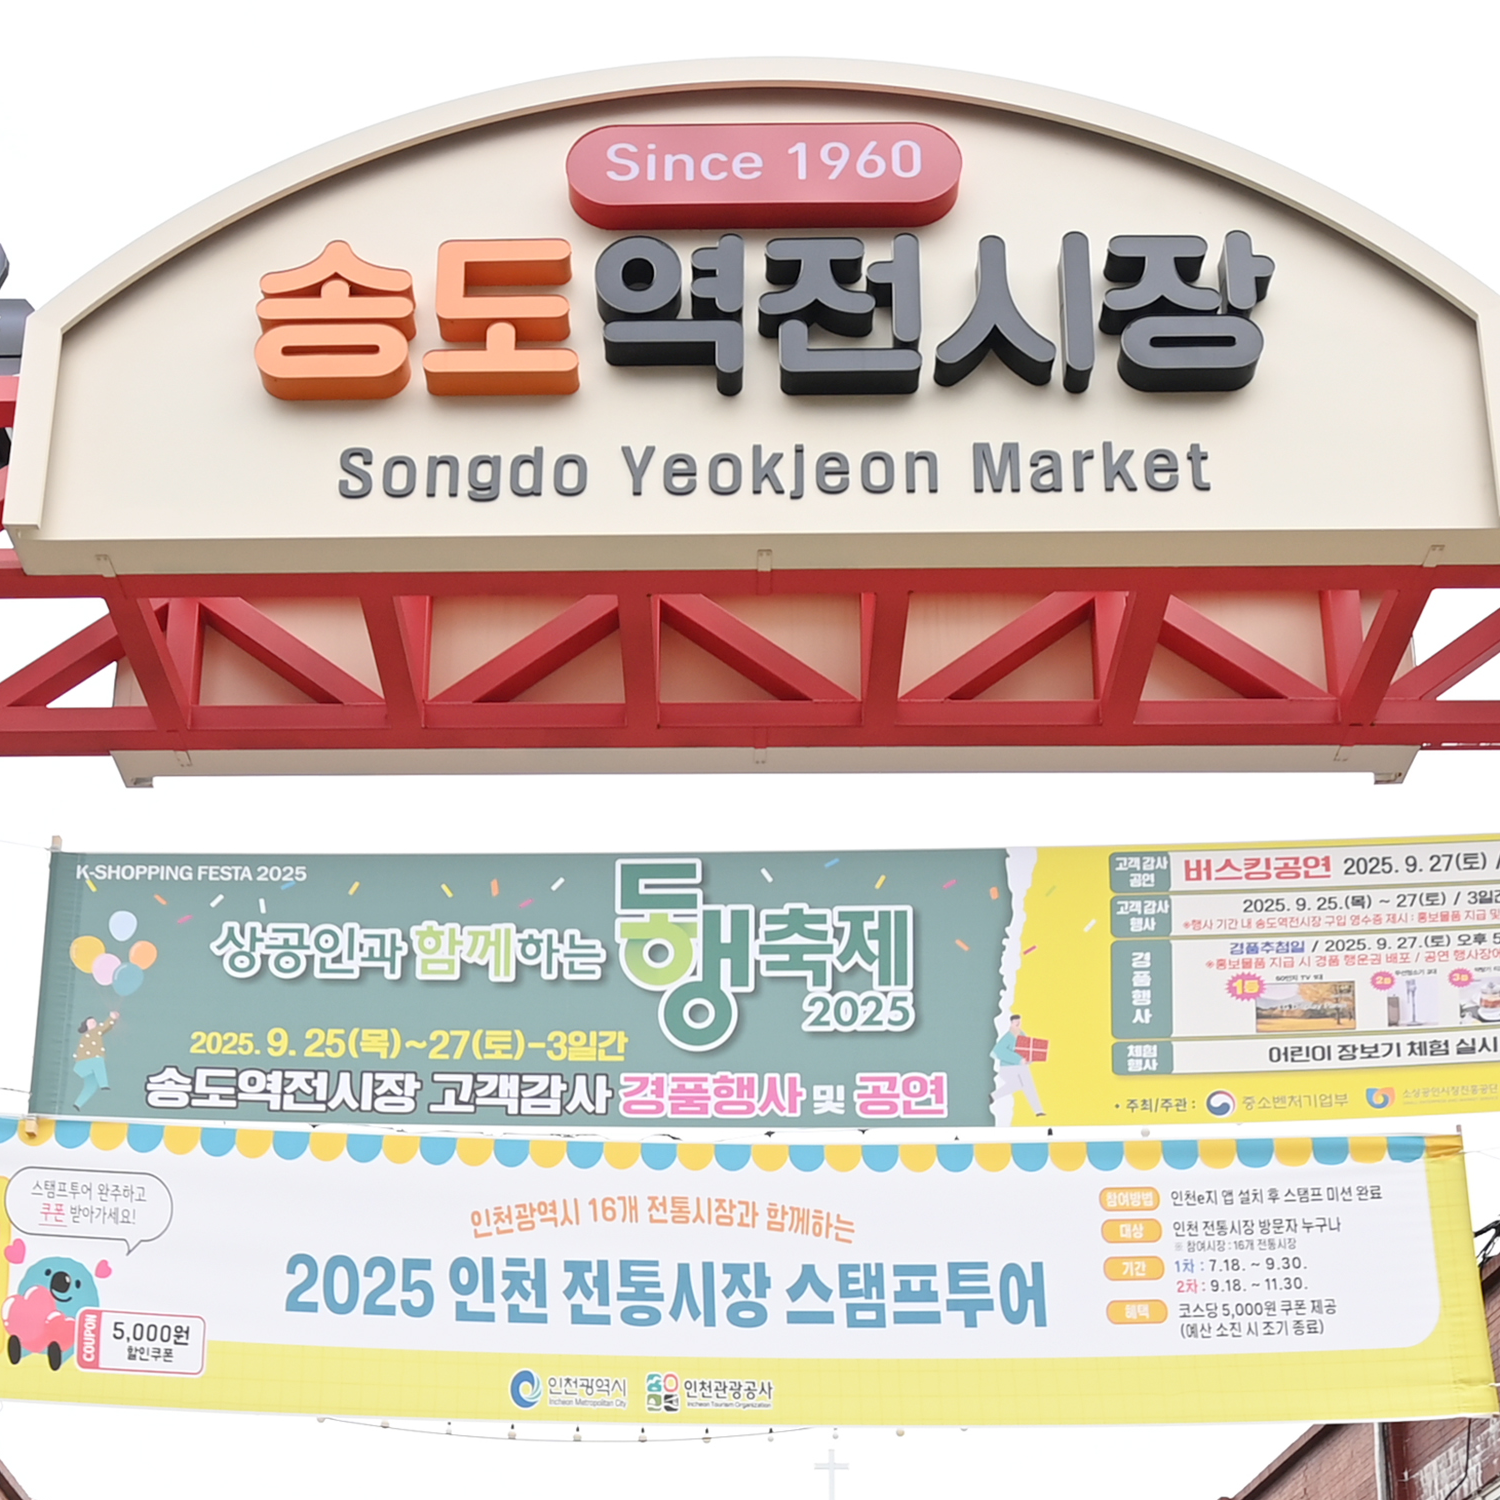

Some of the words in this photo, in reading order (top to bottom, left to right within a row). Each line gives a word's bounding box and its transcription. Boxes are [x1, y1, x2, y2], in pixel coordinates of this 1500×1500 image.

[604, 139, 765, 184] Since
[785, 139, 926, 181] 1960
[254, 229, 1275, 399] 송도역전시장
[338, 446, 588, 502] Songdo
[621, 443, 940, 502] Yeokjeon
[973, 441, 1212, 495] Market
[76, 864, 193, 881] K-SHOPPING
[197, 865, 252, 881] FESTA
[257, 865, 307, 881] 2025
[1184, 856, 1331, 882] 버스킹공연
[1344, 857, 1399, 875] 2025.
[1405, 856, 1423, 873] 9.
[1430, 852, 1487, 872] 27(토)
[1243, 899, 1290, 913] 2025.
[1397, 893, 1446, 908] 27(토)
[214, 923, 406, 979] 상공인과
[412, 923, 605, 981] 함께하는
[802, 992, 915, 1031] 2025
[190, 1031, 261, 1056] 2025.
[267, 1029, 296, 1056] 9.
[1269, 1046, 1331, 1062] 어린이
[1337, 1043, 1402, 1061] 장보기
[1407, 1040, 1449, 1057] 체험
[1456, 1037, 1498, 1053] 실시
[146, 1067, 420, 1114] 송도역전시장
[428, 1070, 611, 1116] 고객감사
[620, 1073, 805, 1118] 경품행사
[813, 1085, 845, 1114] 및
[857, 1073, 947, 1118] 공연
[1242, 1093, 1348, 1110] 중소벤처기업부
[31, 1180, 92, 1199] 스탬프투어
[97, 1183, 147, 1202] 완주하고
[1356, 1186, 1382, 1200] 완료
[70, 1205, 136, 1224] 받아가세요!
[470, 1197, 580, 1239] 인천광역시
[588, 1196, 639, 1223] 16개
[647, 1196, 759, 1229] 전통시장과
[767, 1202, 855, 1244] 함께하는
[1173, 1221, 1199, 1237] 인천
[1202, 1220, 1254, 1236] 전통시장
[1259, 1219, 1297, 1234] 방문자
[1302, 1217, 1341, 1233] 누구나
[285, 1253, 435, 1319] 2025
[449, 1256, 549, 1325] 인천
[562, 1258, 771, 1329] 전통시장
[785, 1261, 1048, 1329] 스탬프투어
[1222, 1301, 1277, 1317] 5,000원
[82, 1314, 97, 1362] COUPON
[113, 1321, 190, 1346] 5,000원
[127, 1346, 174, 1363] 할인쿠폰
[548, 1376, 627, 1397] 인천광역시
[684, 1379, 773, 1400] 인천관광공사
